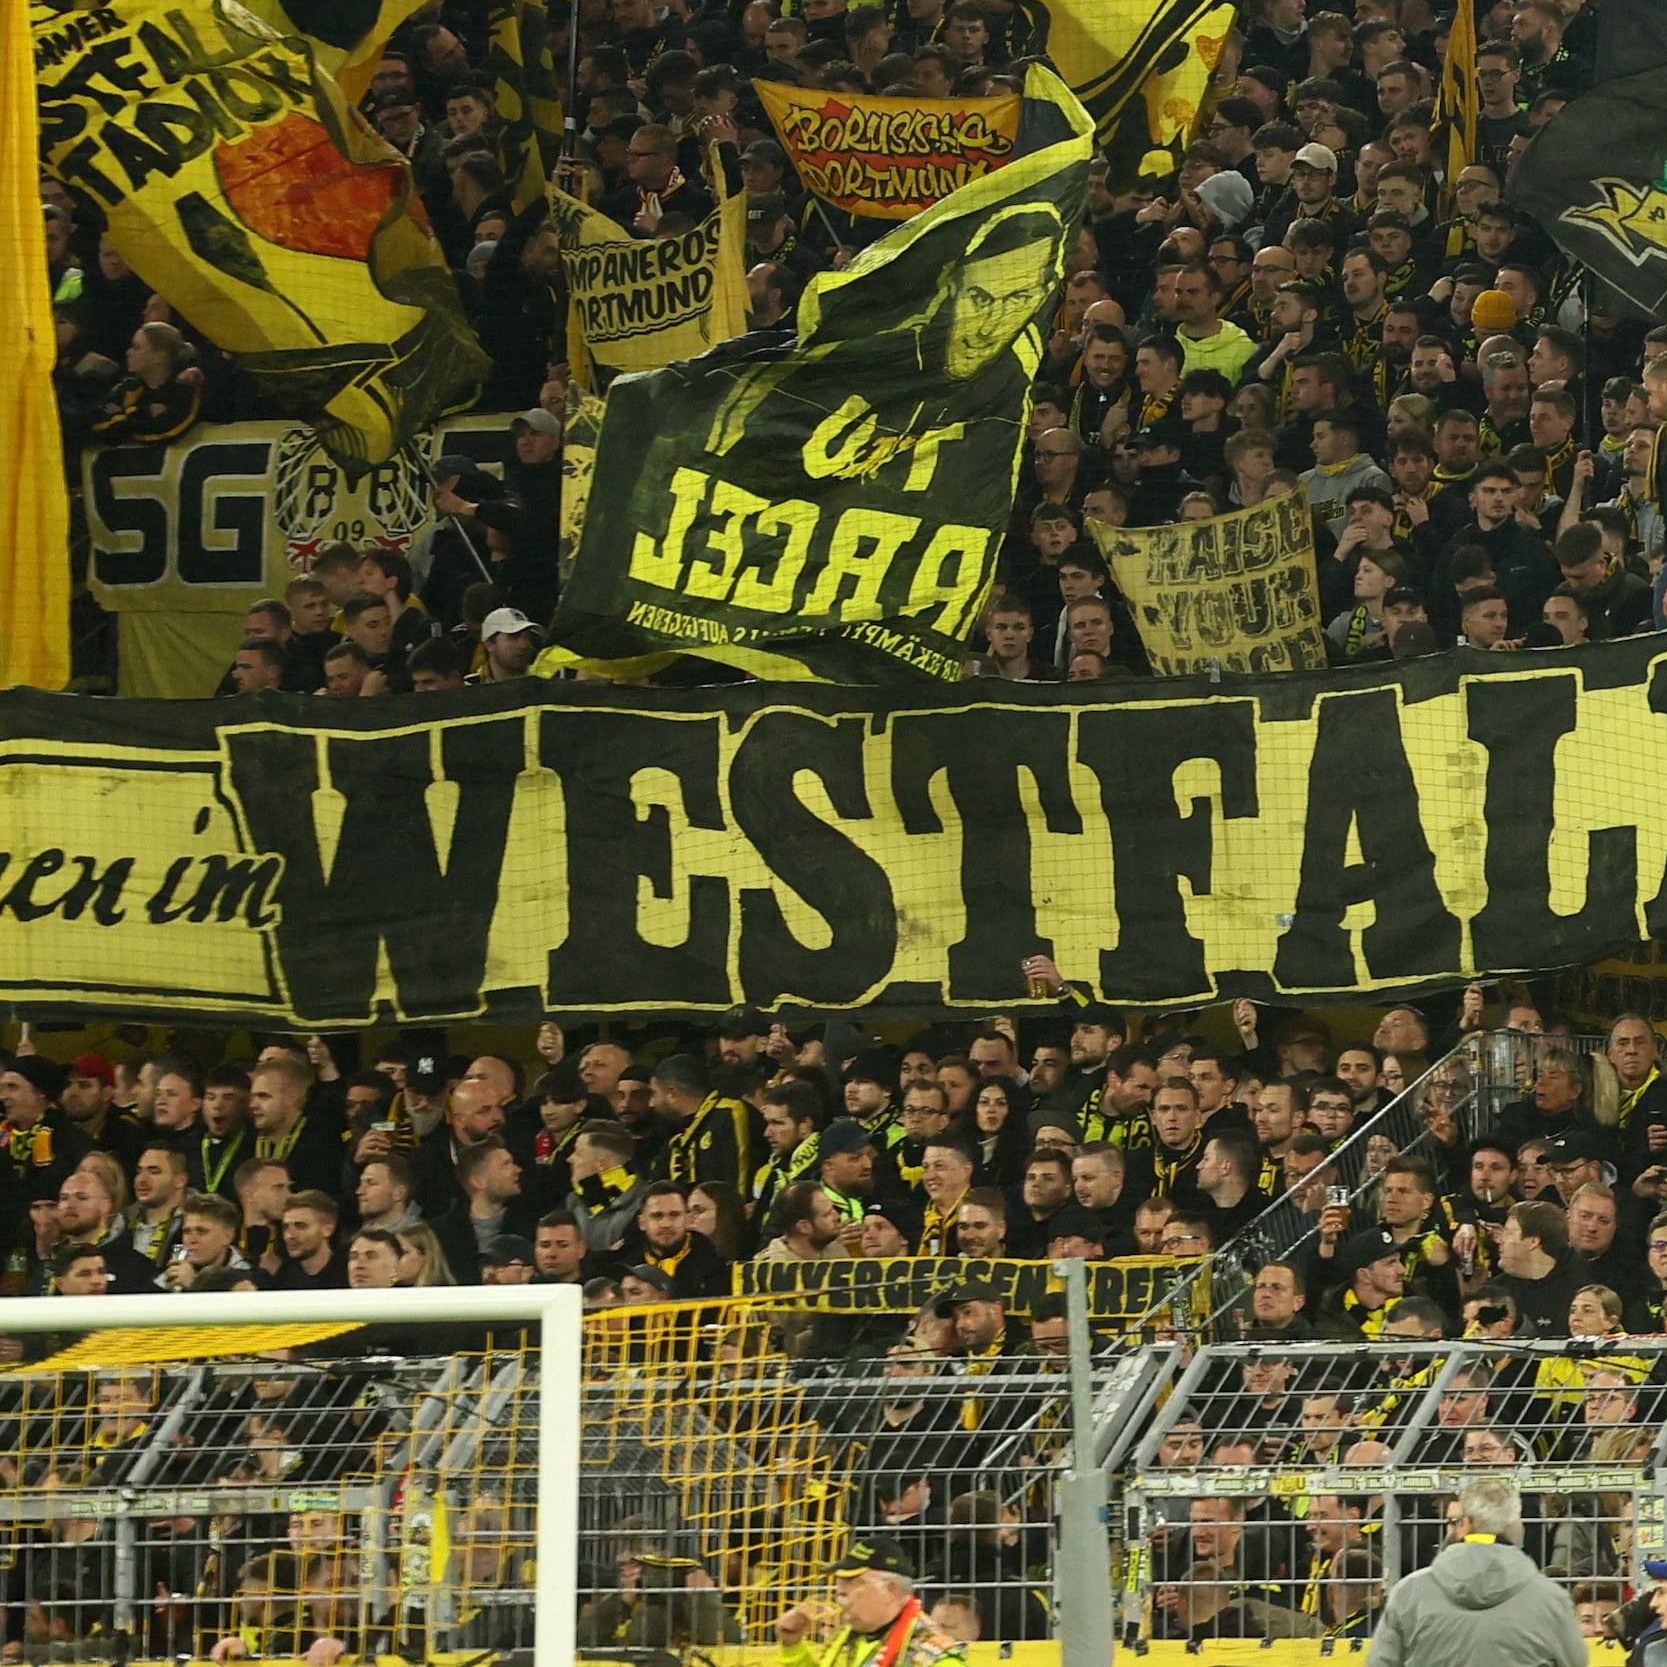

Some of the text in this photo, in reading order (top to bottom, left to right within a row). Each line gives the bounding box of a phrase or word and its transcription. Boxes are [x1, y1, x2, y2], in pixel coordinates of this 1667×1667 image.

[782, 103, 1013, 157] BORUSSIA
[91, 440, 270, 585] SG
[333, 520, 365, 542] 09
[1146, 492, 1312, 586] RAISE
[147, 804, 284, 928] im
